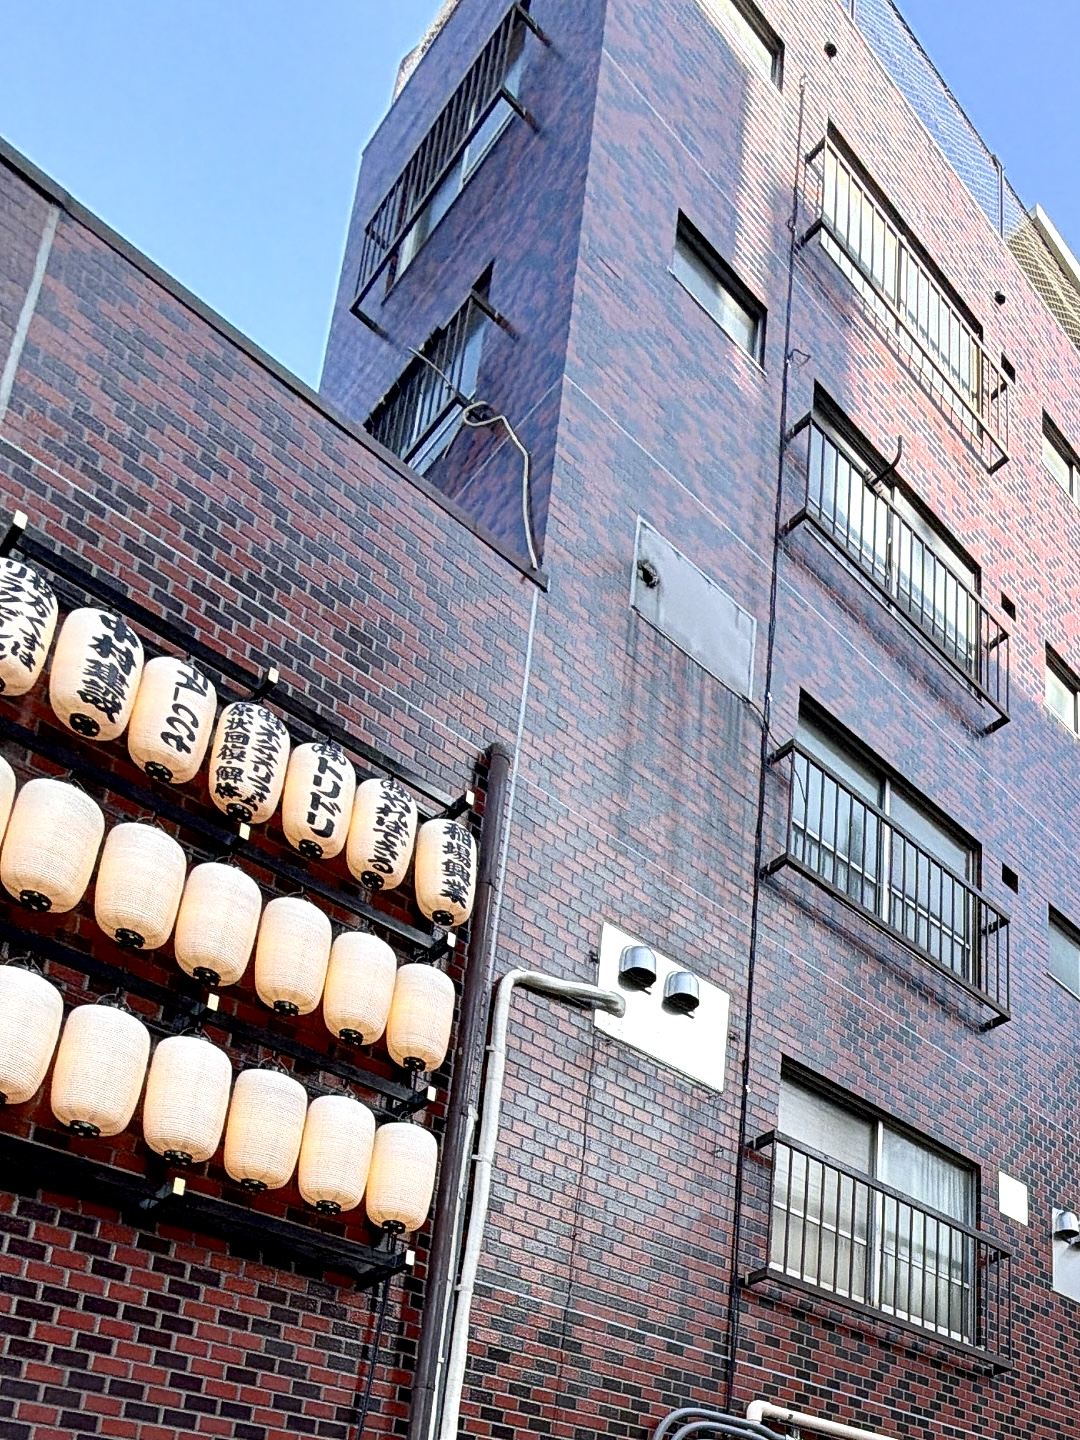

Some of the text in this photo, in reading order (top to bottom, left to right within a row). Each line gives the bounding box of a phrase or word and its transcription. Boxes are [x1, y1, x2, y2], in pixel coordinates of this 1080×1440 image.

[77, 613, 139, 724] 中村建設
[440, 822, 472, 909] 稲場興業
